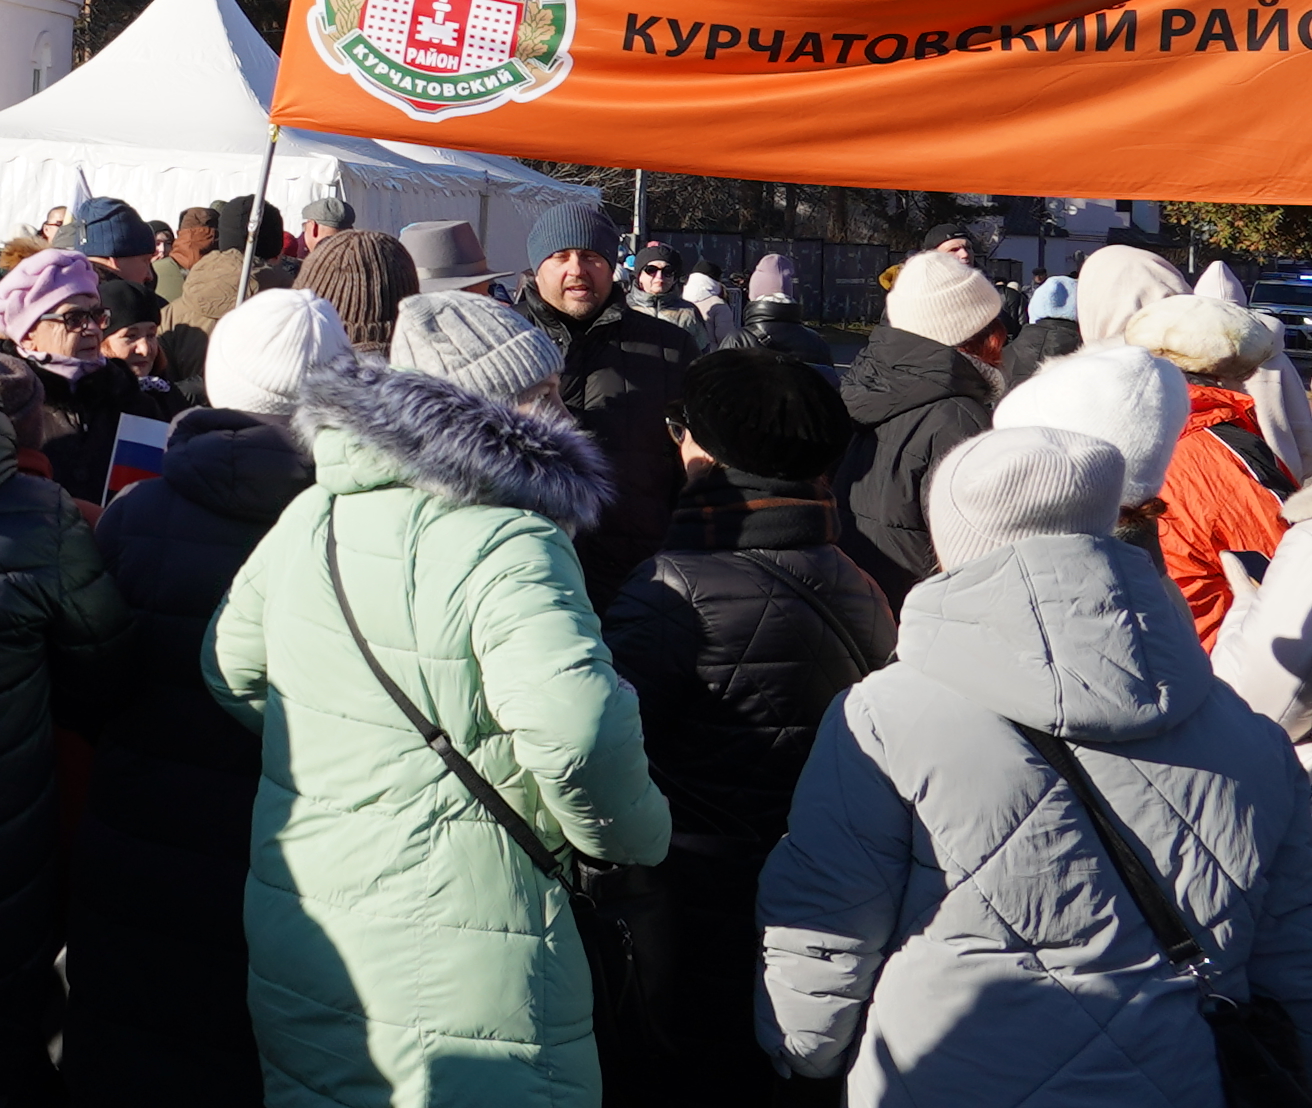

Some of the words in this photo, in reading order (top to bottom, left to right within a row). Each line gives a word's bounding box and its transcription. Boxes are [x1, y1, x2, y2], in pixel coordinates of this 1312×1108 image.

[406, 46, 460, 71] РАЙОН
[622, 1, 1138, 64] КУРЧАТОВСКИЙ
[352, 43, 515, 97] КУРЧАТОВСКИЙ
